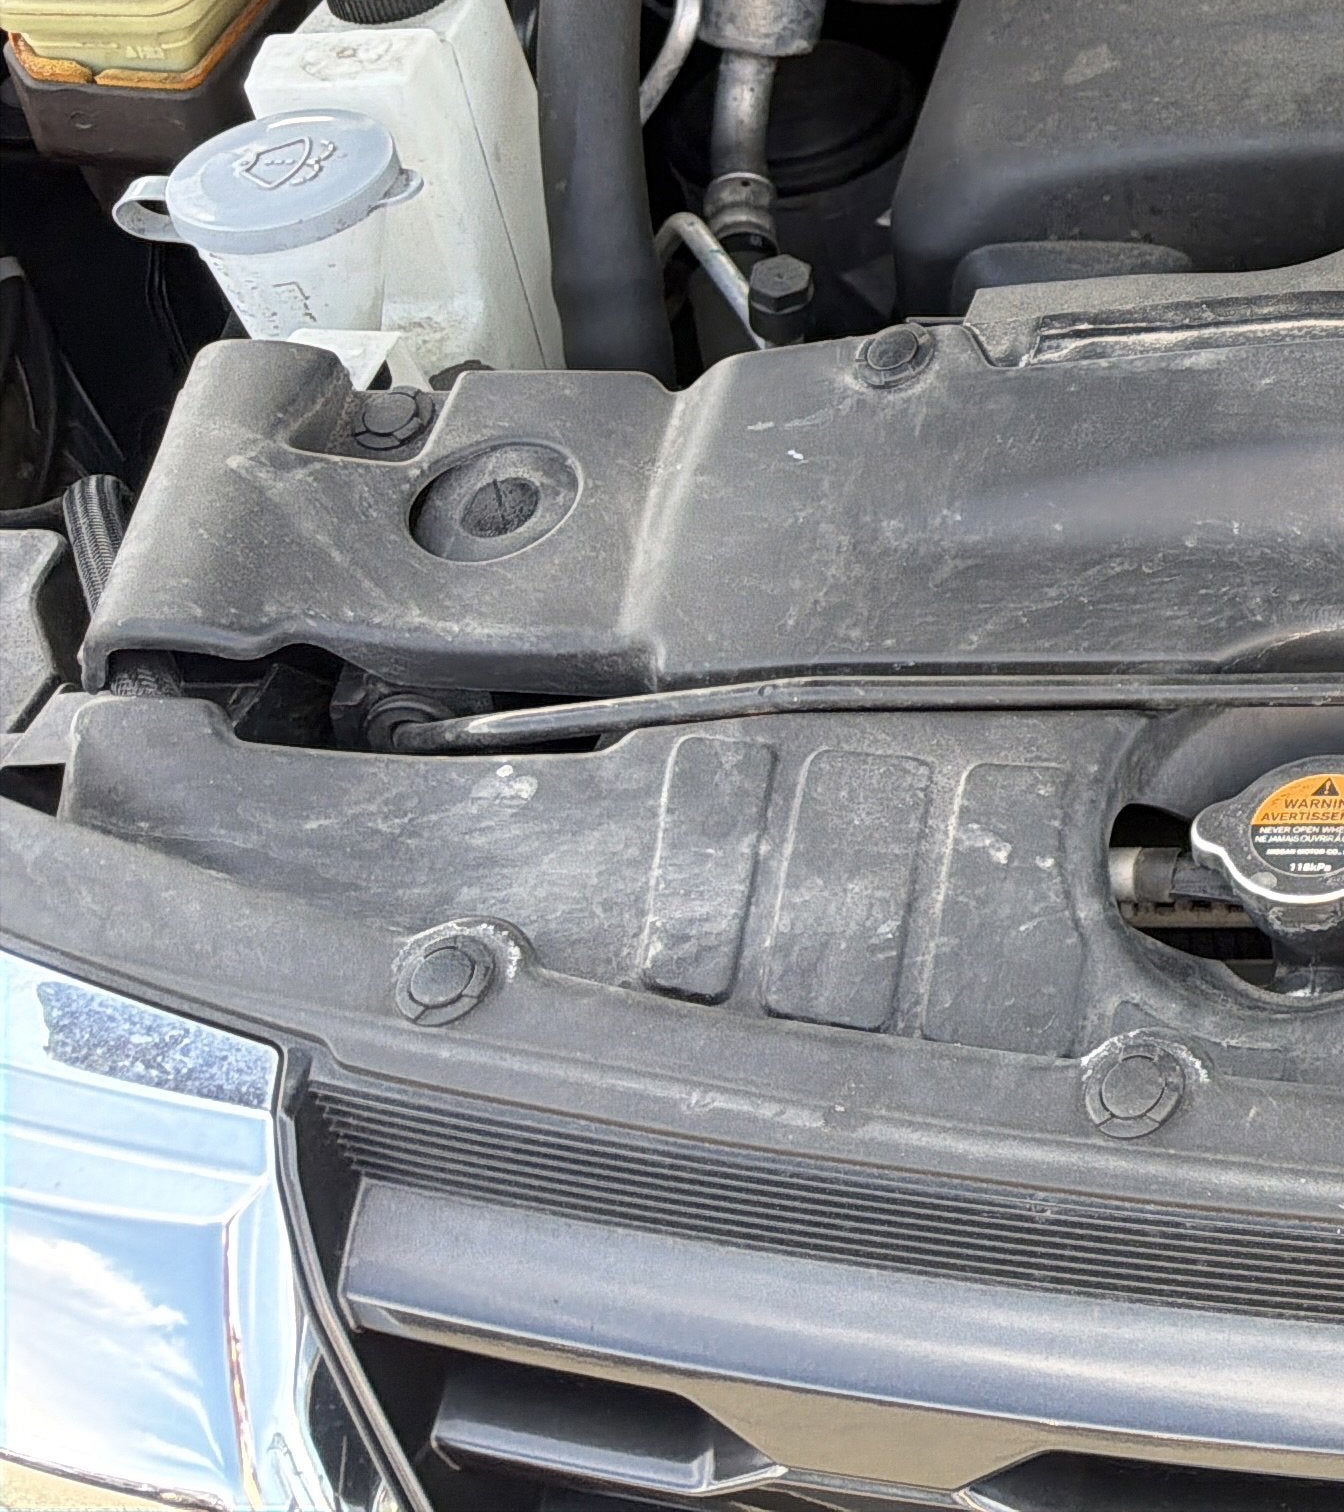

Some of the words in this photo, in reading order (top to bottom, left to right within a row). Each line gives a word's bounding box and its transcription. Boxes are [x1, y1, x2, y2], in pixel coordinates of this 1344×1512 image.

[1259, 826, 1291, 834] NEVER
[1293, 826, 1319, 834] OPEN
[1254, 835, 1267, 843] NE
